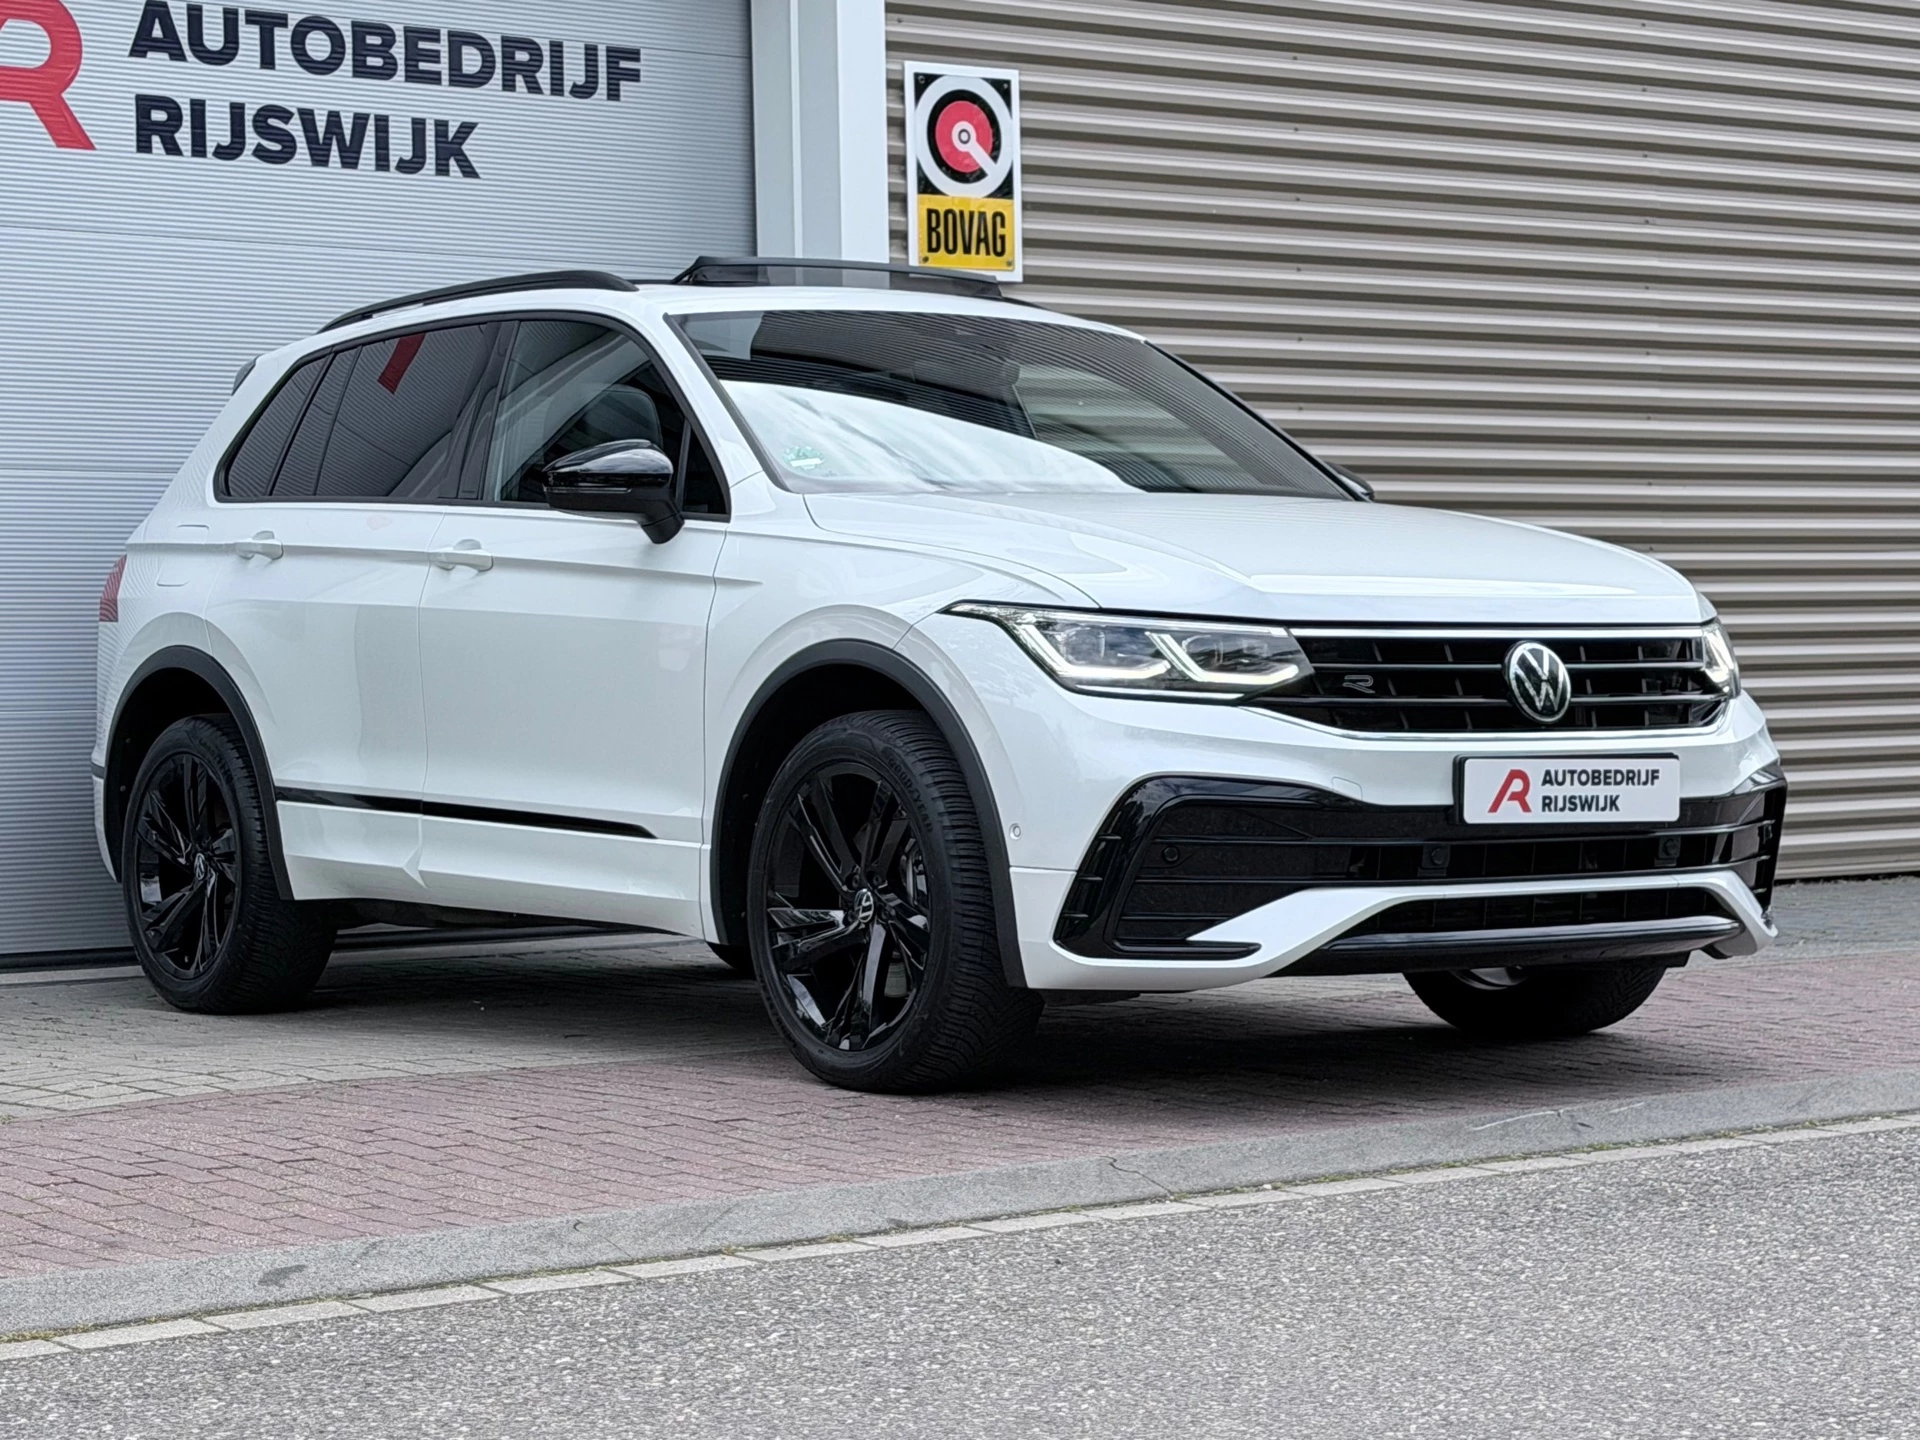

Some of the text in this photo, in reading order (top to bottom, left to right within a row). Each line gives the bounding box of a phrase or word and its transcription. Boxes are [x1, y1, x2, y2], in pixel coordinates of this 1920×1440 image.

[128, 0, 641, 101] AUTOBEDRIJF
[134, 93, 481, 179] RIJSWIJK
[926, 208, 1006, 257] BOVAG
[1541, 769, 1660, 786] AUTOBEDRIJF
[1541, 795, 1621, 812] RIJSWIJK
